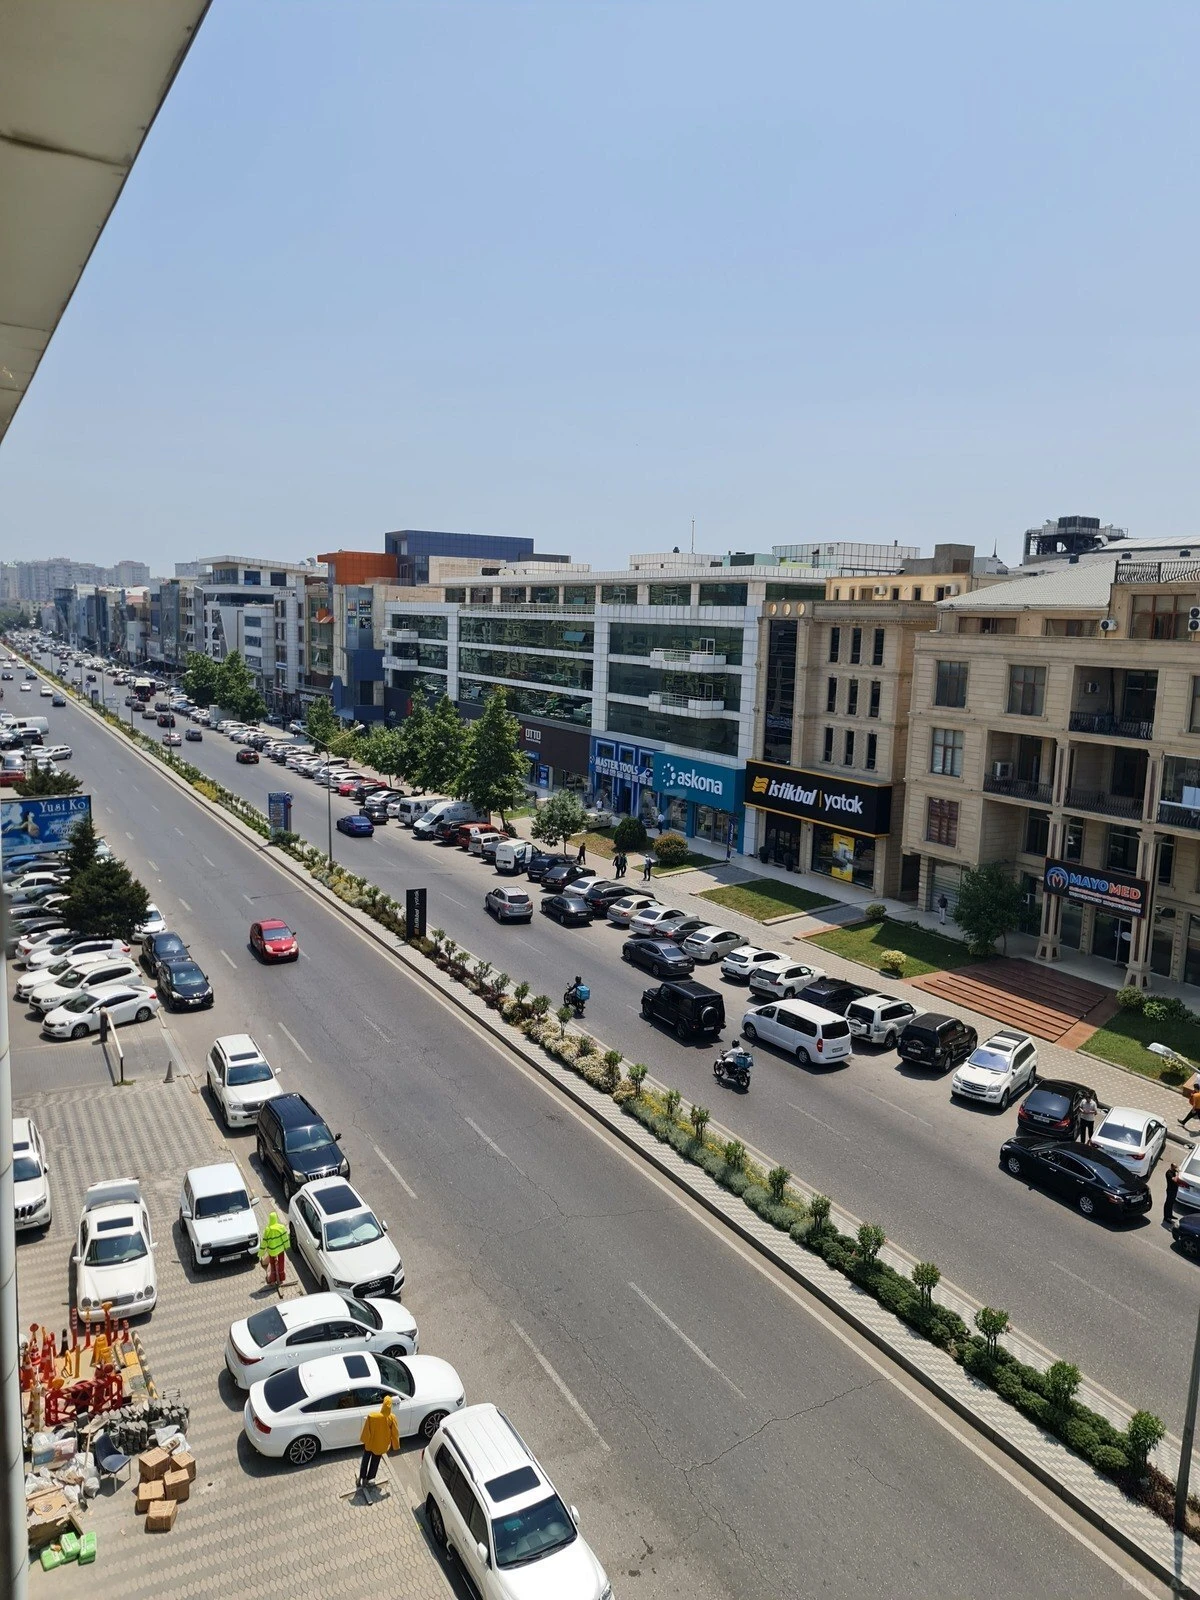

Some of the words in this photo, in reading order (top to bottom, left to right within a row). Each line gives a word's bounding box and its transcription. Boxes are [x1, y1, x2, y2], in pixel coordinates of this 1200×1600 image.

[525, 728, 541, 740] OTTO
[595, 756, 619, 770] MASTER
[619, 762, 639, 775] TOOLS
[677, 769, 723, 795] askona
[40, 800, 66, 813] Yusi
[768, 779, 818, 806] istikbal
[824, 793, 863, 814] yatak
[1069, 872, 1141, 900] MAYOMED
